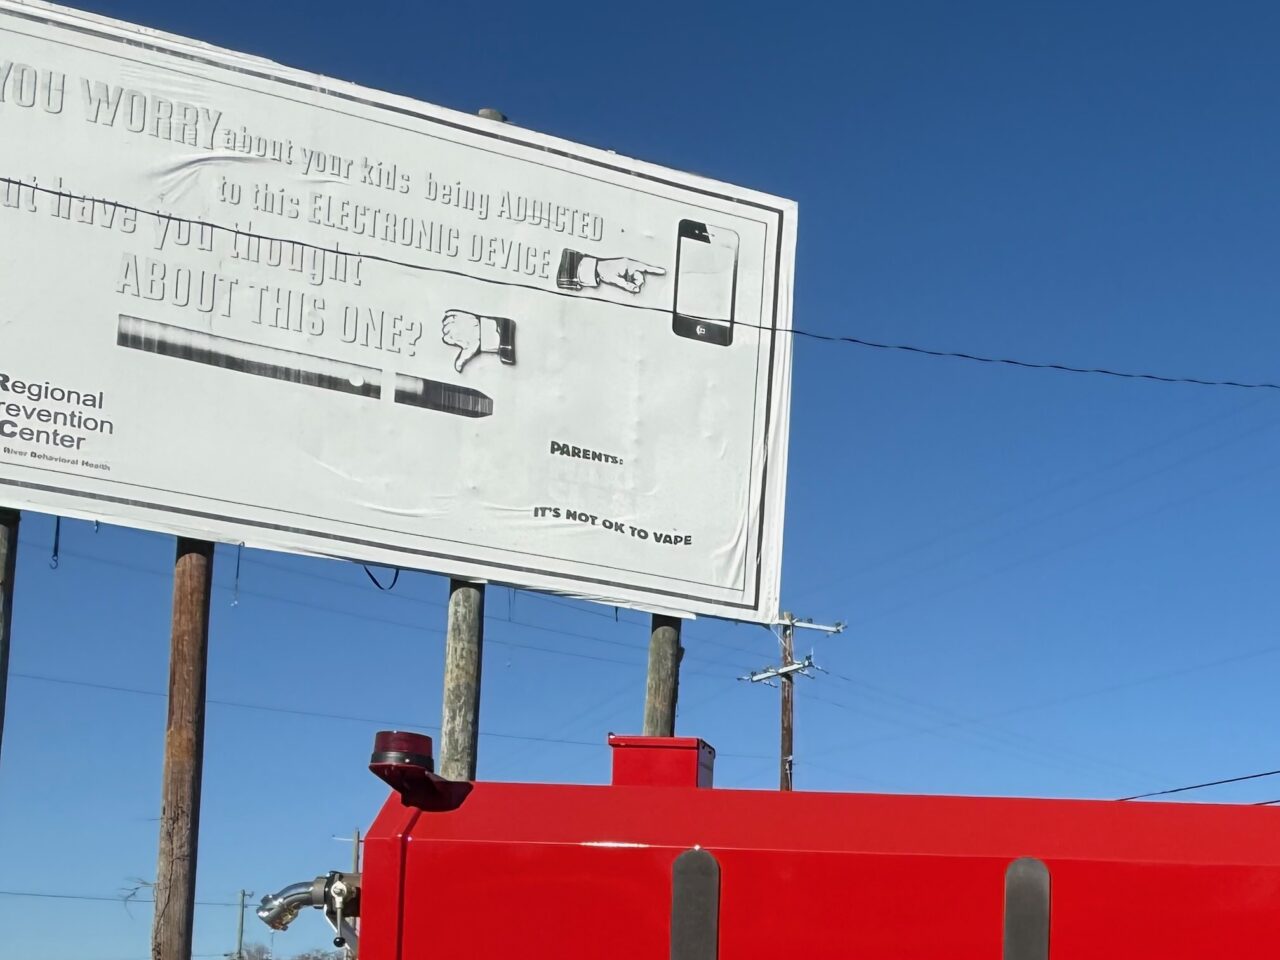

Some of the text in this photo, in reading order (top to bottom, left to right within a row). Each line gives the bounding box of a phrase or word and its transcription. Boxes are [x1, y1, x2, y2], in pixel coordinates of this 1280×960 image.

[0, 61, 604, 242] YOU WORRY about your kids being ADDICTED
[50, 177, 138, 234] have
[152, 208, 215, 252] you
[229, 221, 363, 287] thought
[218, 176, 551, 279] to this ELECTRONIC DEVICE
[115, 252, 424, 357] ABOUT THIS ONE?
[0, 372, 104, 410] Regional
[0, 419, 87, 451] Center
[550, 440, 624, 465] PARENTS:
[30, 450, 79, 466] Behavioral
[81, 459, 111, 472] Health
[533, 506, 693, 546] IT'S NOT OK TO VAPE
